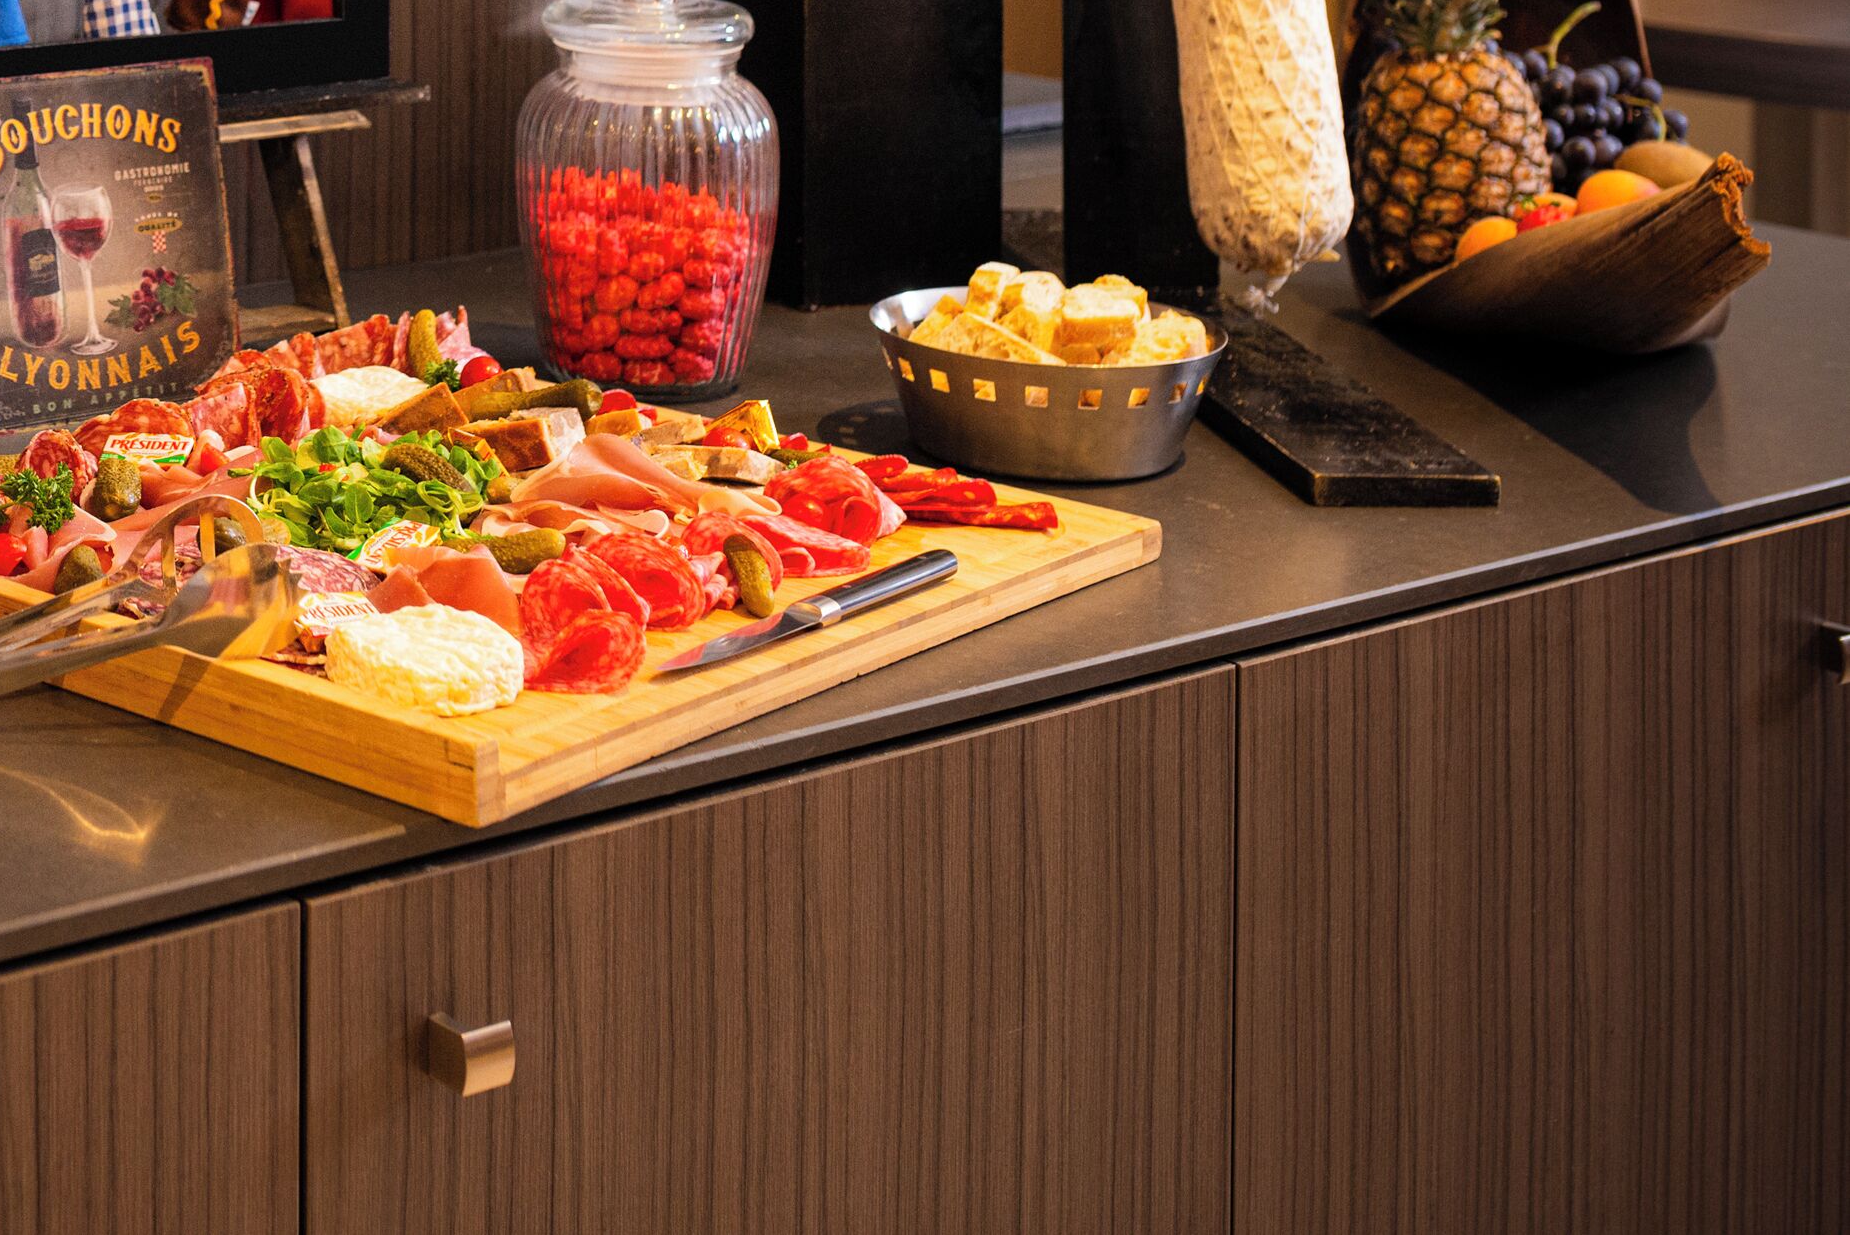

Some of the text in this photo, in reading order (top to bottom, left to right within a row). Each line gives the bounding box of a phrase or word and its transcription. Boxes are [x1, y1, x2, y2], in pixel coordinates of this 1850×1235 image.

[114, 162, 190, 182] GASTRONOMIE
[32, 399, 73, 415] BON
[110, 438, 190, 451] PRÉSIDENT
